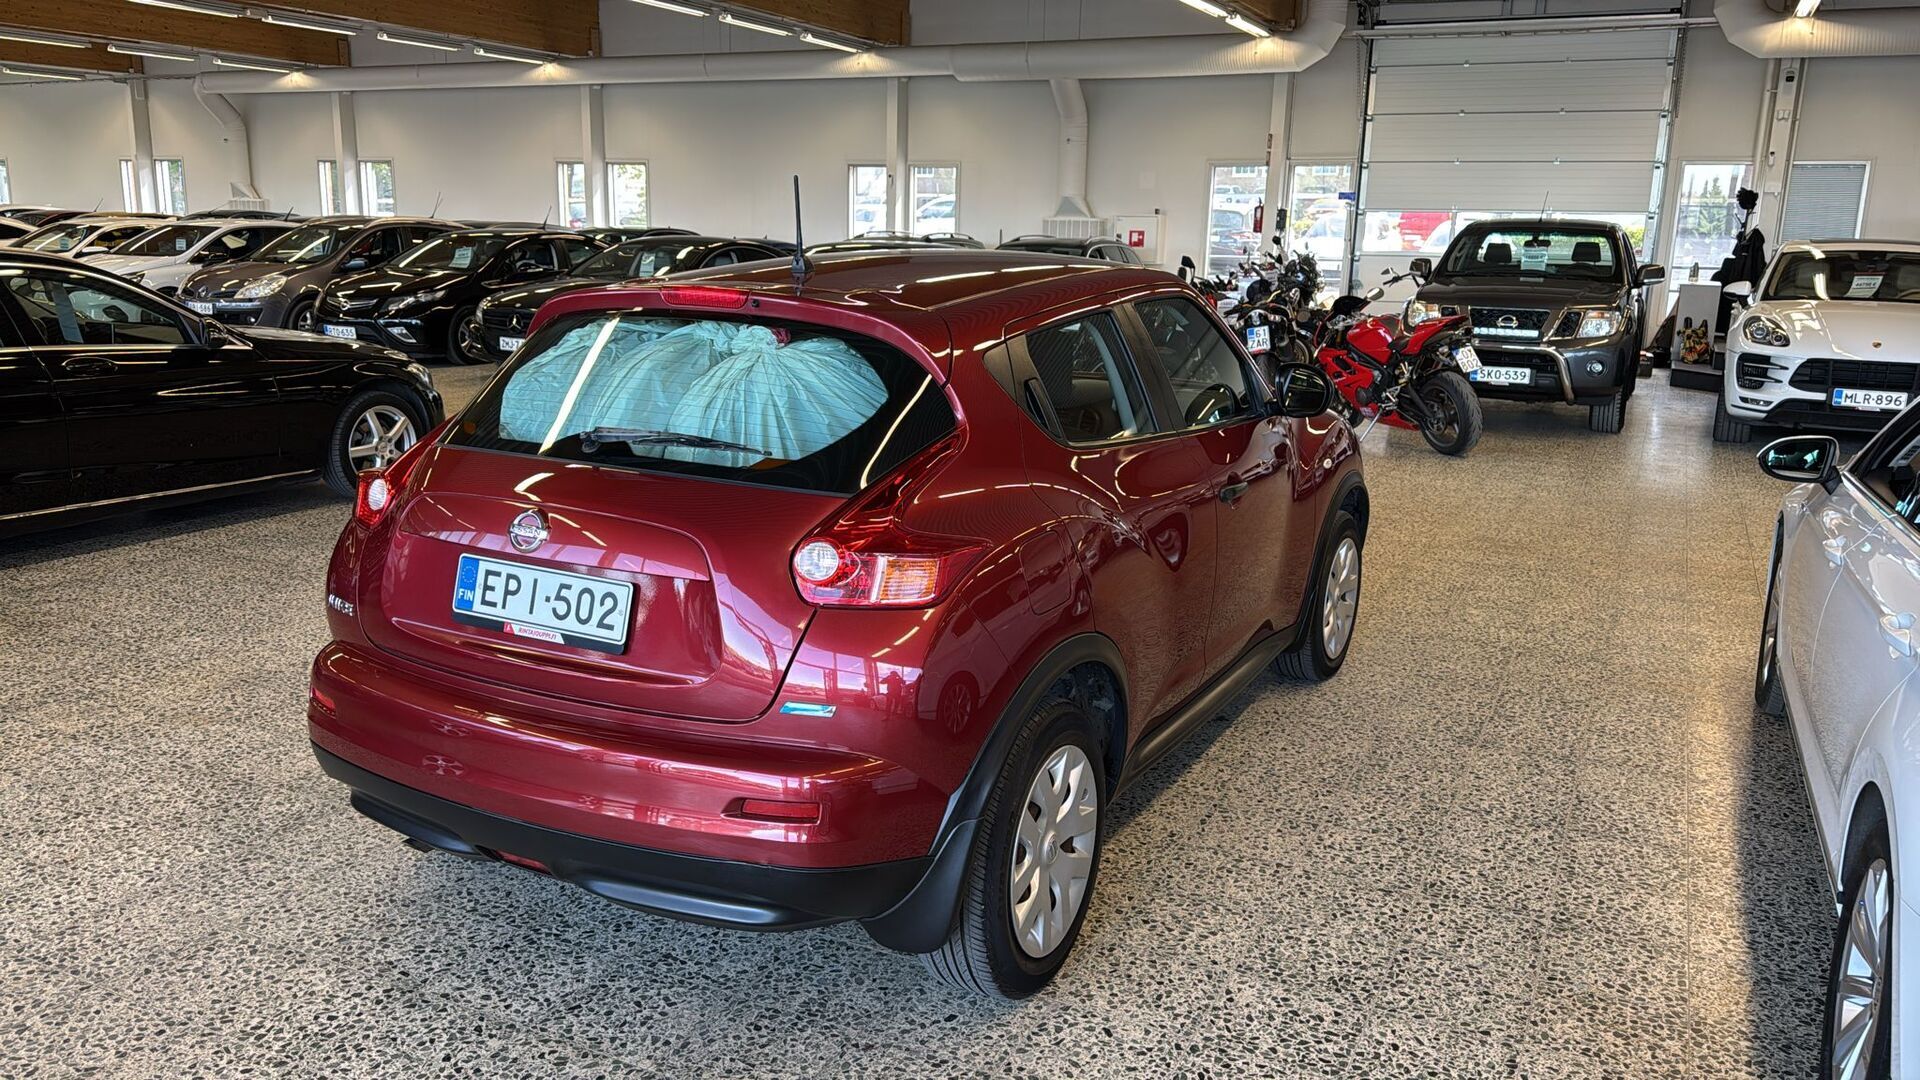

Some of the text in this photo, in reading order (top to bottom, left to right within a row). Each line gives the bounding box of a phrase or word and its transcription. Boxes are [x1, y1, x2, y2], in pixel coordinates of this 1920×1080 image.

[1255, 328, 1266, 338] 61
[501, 339, 522, 349] ZMJ-7
[1250, 338, 1268, 349] ZAR
[1461, 359, 1480, 371] 802
[1480, 369, 1527, 381] SKO-539
[1844, 392, 1902, 407] MLR-896
[458, 588, 474, 601] FIN
[480, 568, 619, 631] EPI-502
